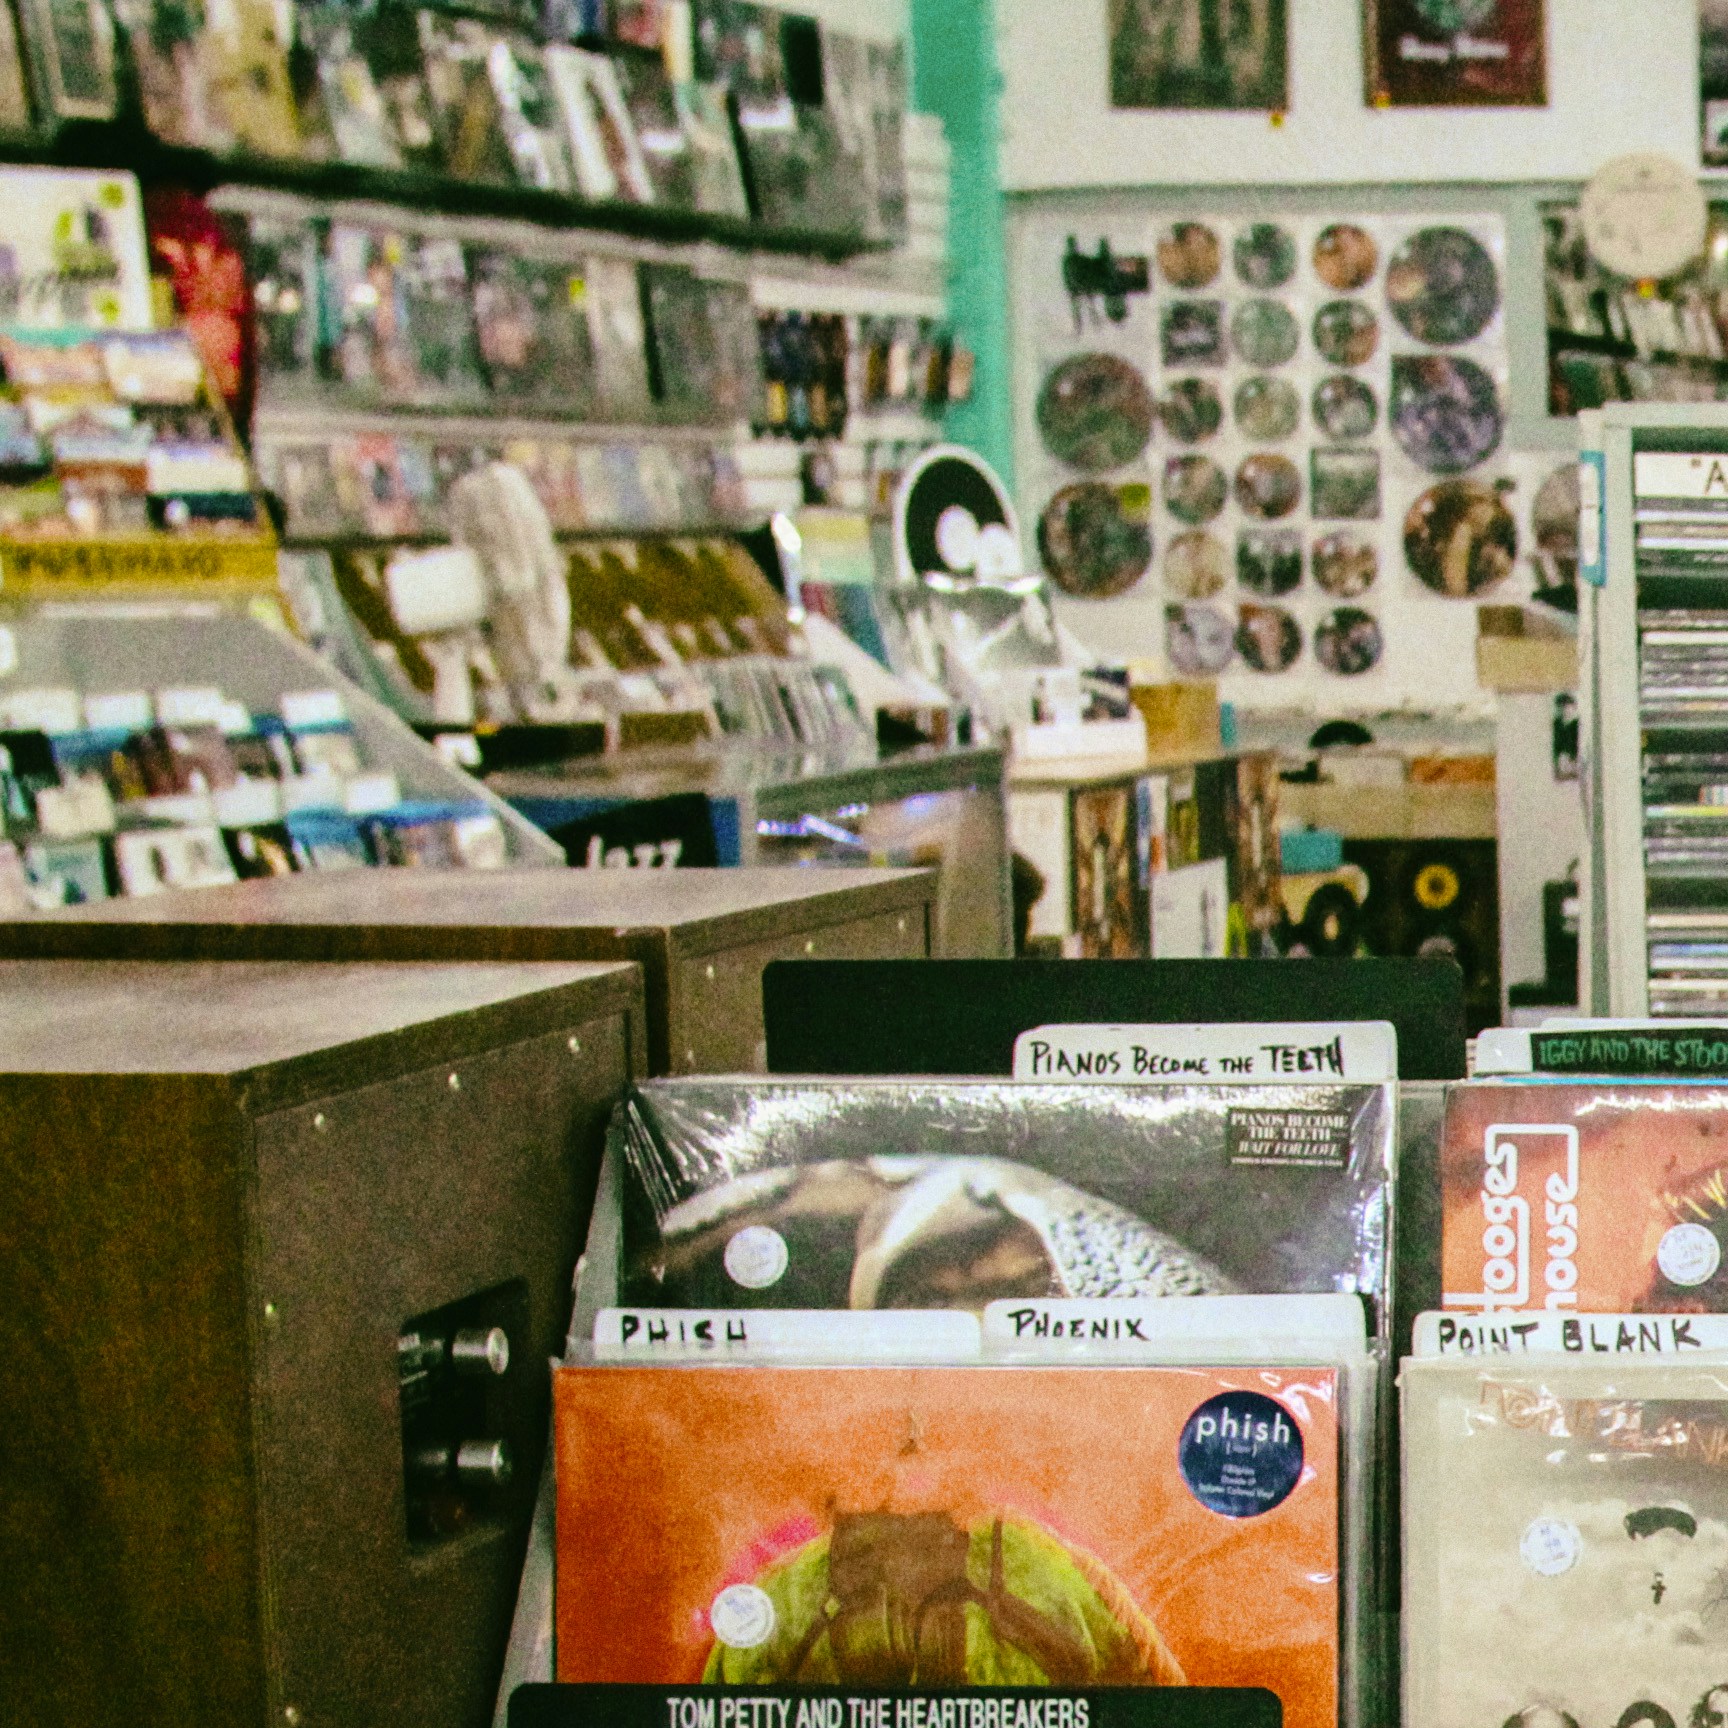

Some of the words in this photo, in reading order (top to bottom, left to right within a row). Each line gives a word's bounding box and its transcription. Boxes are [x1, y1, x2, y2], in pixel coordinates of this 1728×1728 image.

[1030, 1044, 1123, 1077] PIANOS
[1132, 1046, 1212, 1075] BECOME
[1219, 1056, 1254, 1074] THE
[1539, 1038, 1590, 1065] IGGY
[1590, 1037, 1629, 1063] AND
[1629, 1037, 1671, 1063] THE
[1231, 1113, 1285, 1126] PIANOS
[1288, 1114, 1346, 1128] BECOME
[1250, 1126, 1277, 1140] THE
[1283, 1127, 1331, 1141] TEETH
[1478, 1124, 1531, 1312] tooges
[1008, 1307, 1148, 1343] PHOENIX
[1437, 1319, 1539, 1354] POINT
[1562, 1318, 1703, 1354] BLANK
[1195, 1406, 1290, 1444] phish
